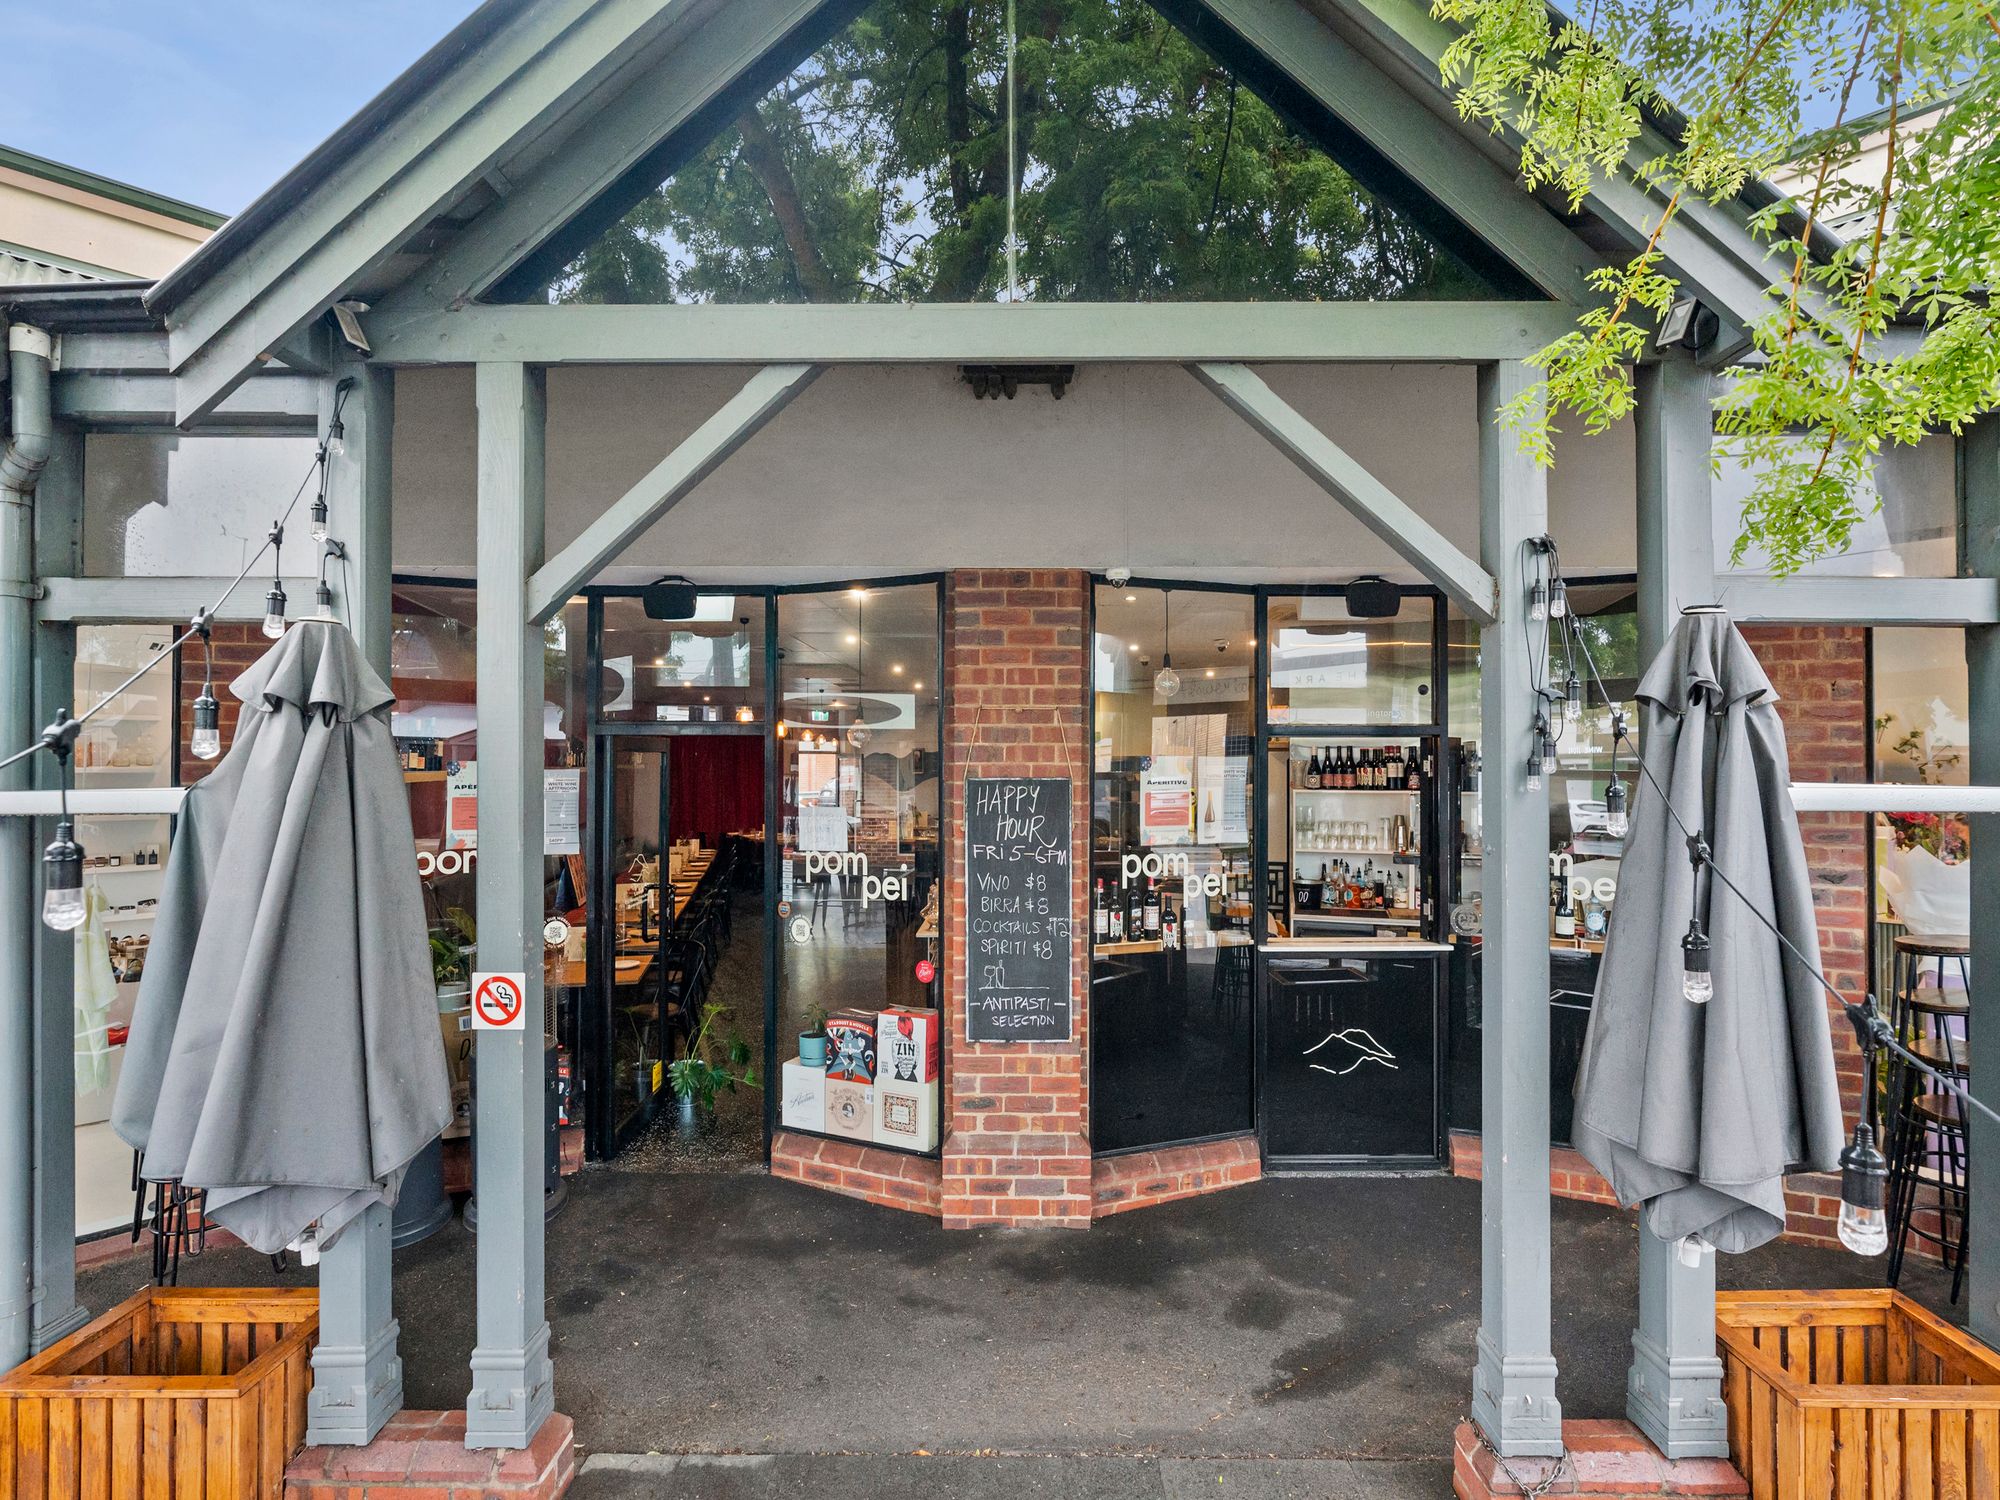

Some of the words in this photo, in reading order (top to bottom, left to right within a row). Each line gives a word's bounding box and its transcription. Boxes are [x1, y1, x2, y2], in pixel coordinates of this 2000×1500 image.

[976, 784, 1040, 816] HAPPY
[996, 814, 1057, 848] HOUR
[805, 850, 868, 884] pom
[1121, 852, 1189, 890] pom
[862, 863, 908, 909] pei
[976, 872, 1010, 893] VINO
[1024, 872, 1047, 892] $8
[1183, 859, 1228, 908] pei
[1566, 876, 1617, 910] pe
[981, 895, 1020, 914] BIRRA
[1024, 897, 1049, 915] $8
[973, 917, 1042, 936] COCKTAILS
[980, 937, 1026, 956] SPIRITI
[1032, 939, 1053, 960] $8
[982, 996, 1050, 1012] ANTIPASTI
[991, 1014, 1055, 1028] SELECTION
[895, 1042, 916, 1057] ZIN
